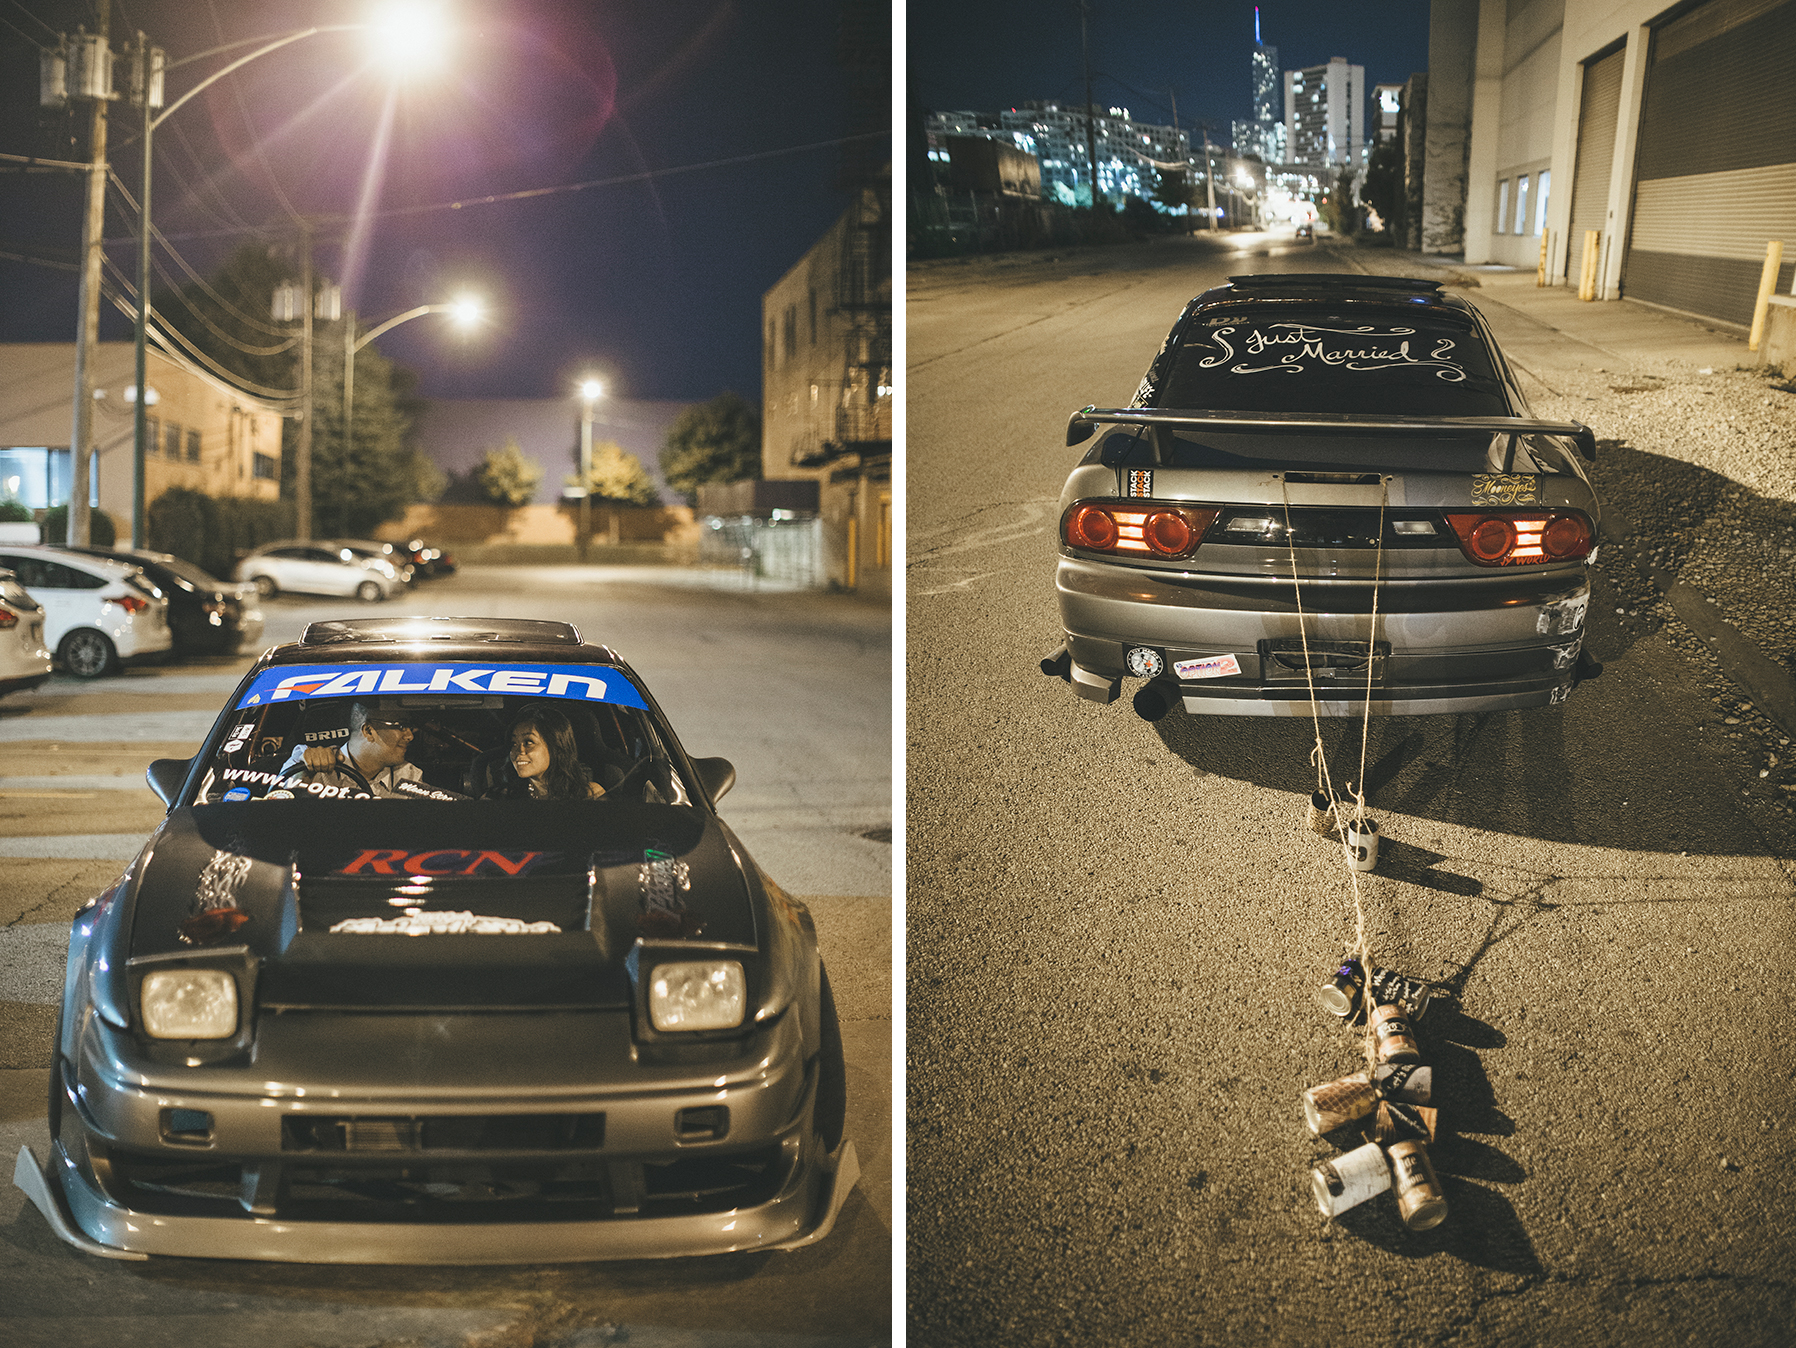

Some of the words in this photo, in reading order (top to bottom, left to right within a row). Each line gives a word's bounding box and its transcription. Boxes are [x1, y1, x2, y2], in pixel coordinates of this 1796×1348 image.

[1246, 328, 1321, 354] Just
[1281, 340, 1418, 365] Married
[1130, 470, 1138, 497] STACK
[1137, 470, 1145, 497] STACK
[1143, 470, 1151, 497] STACK
[269, 669, 607, 700] FALKEN
[304, 727, 350, 742] BRID
[338, 849, 543, 876] RCN
